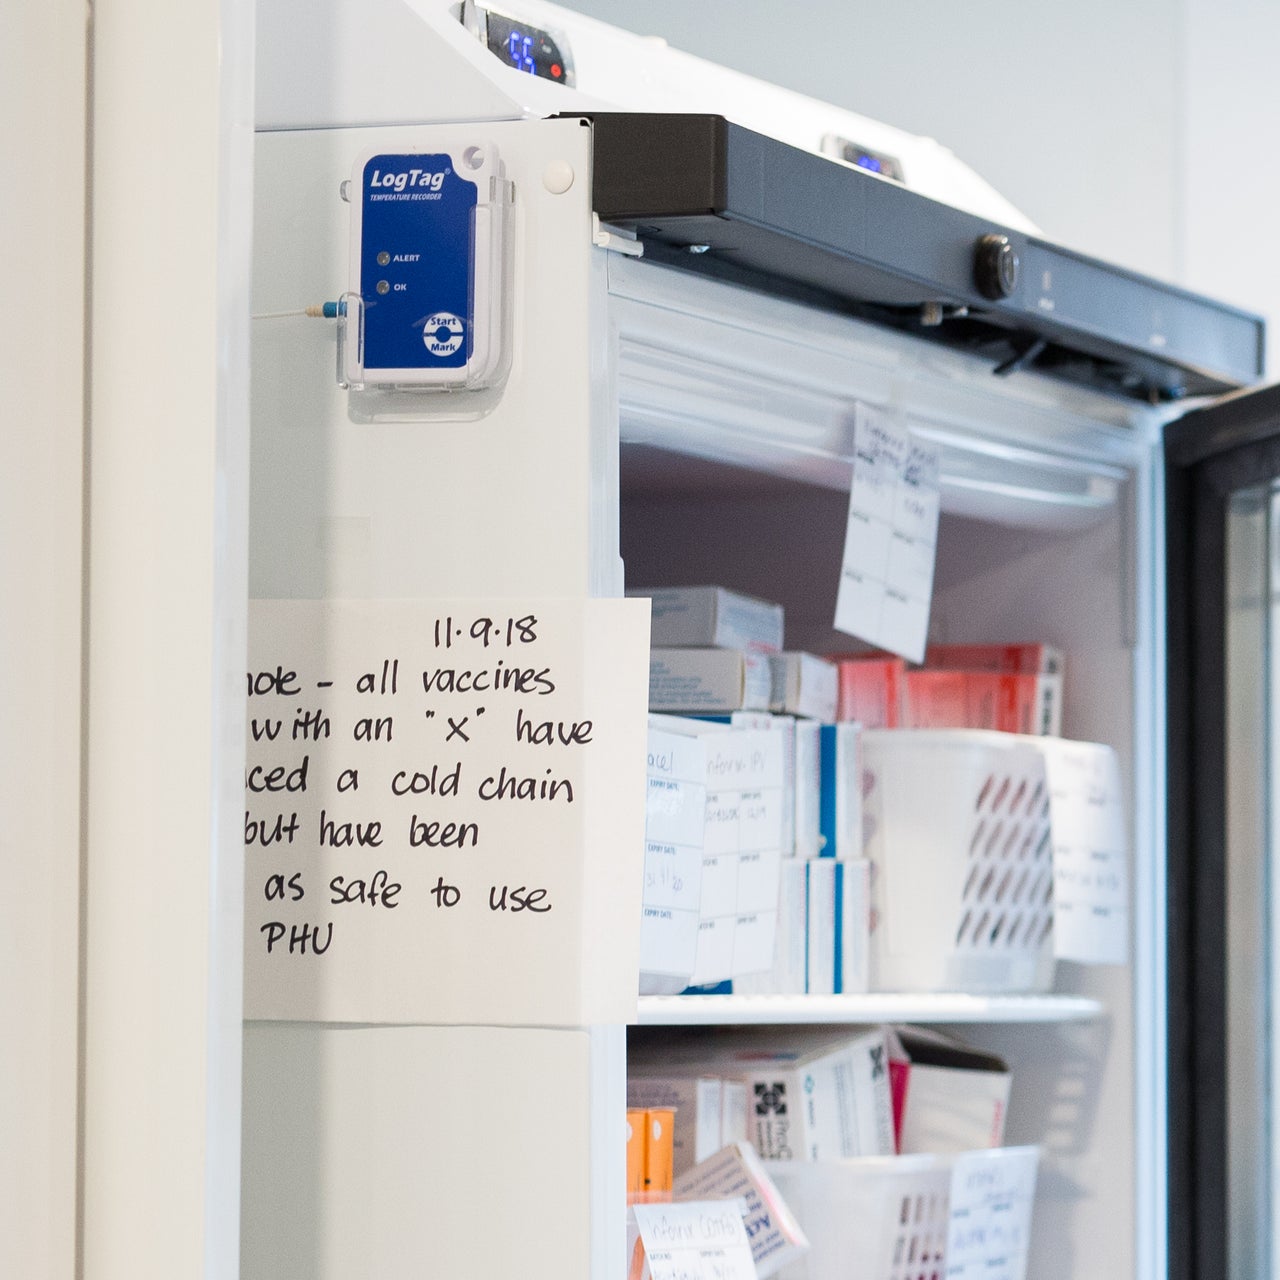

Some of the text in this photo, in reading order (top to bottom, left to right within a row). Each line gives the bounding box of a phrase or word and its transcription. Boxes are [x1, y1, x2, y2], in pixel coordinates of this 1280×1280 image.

[370, 193, 411, 201] TEMPERATURE
[393, 254, 421, 262] ALERT
[430, 316, 457, 326] Start
[430, 342, 457, 352] Mark
[356, 659, 399, 695] all
[423, 659, 556, 696] vaccines
[251, 708, 331, 742] with
[353, 715, 394, 743] an
[516, 708, 594, 746] have
[244, 755, 574, 803] ced a cold chain
[244, 809, 479, 848] but have been
[264, 870, 552, 913] as safe to use
[260, 922, 334, 955] PHU
